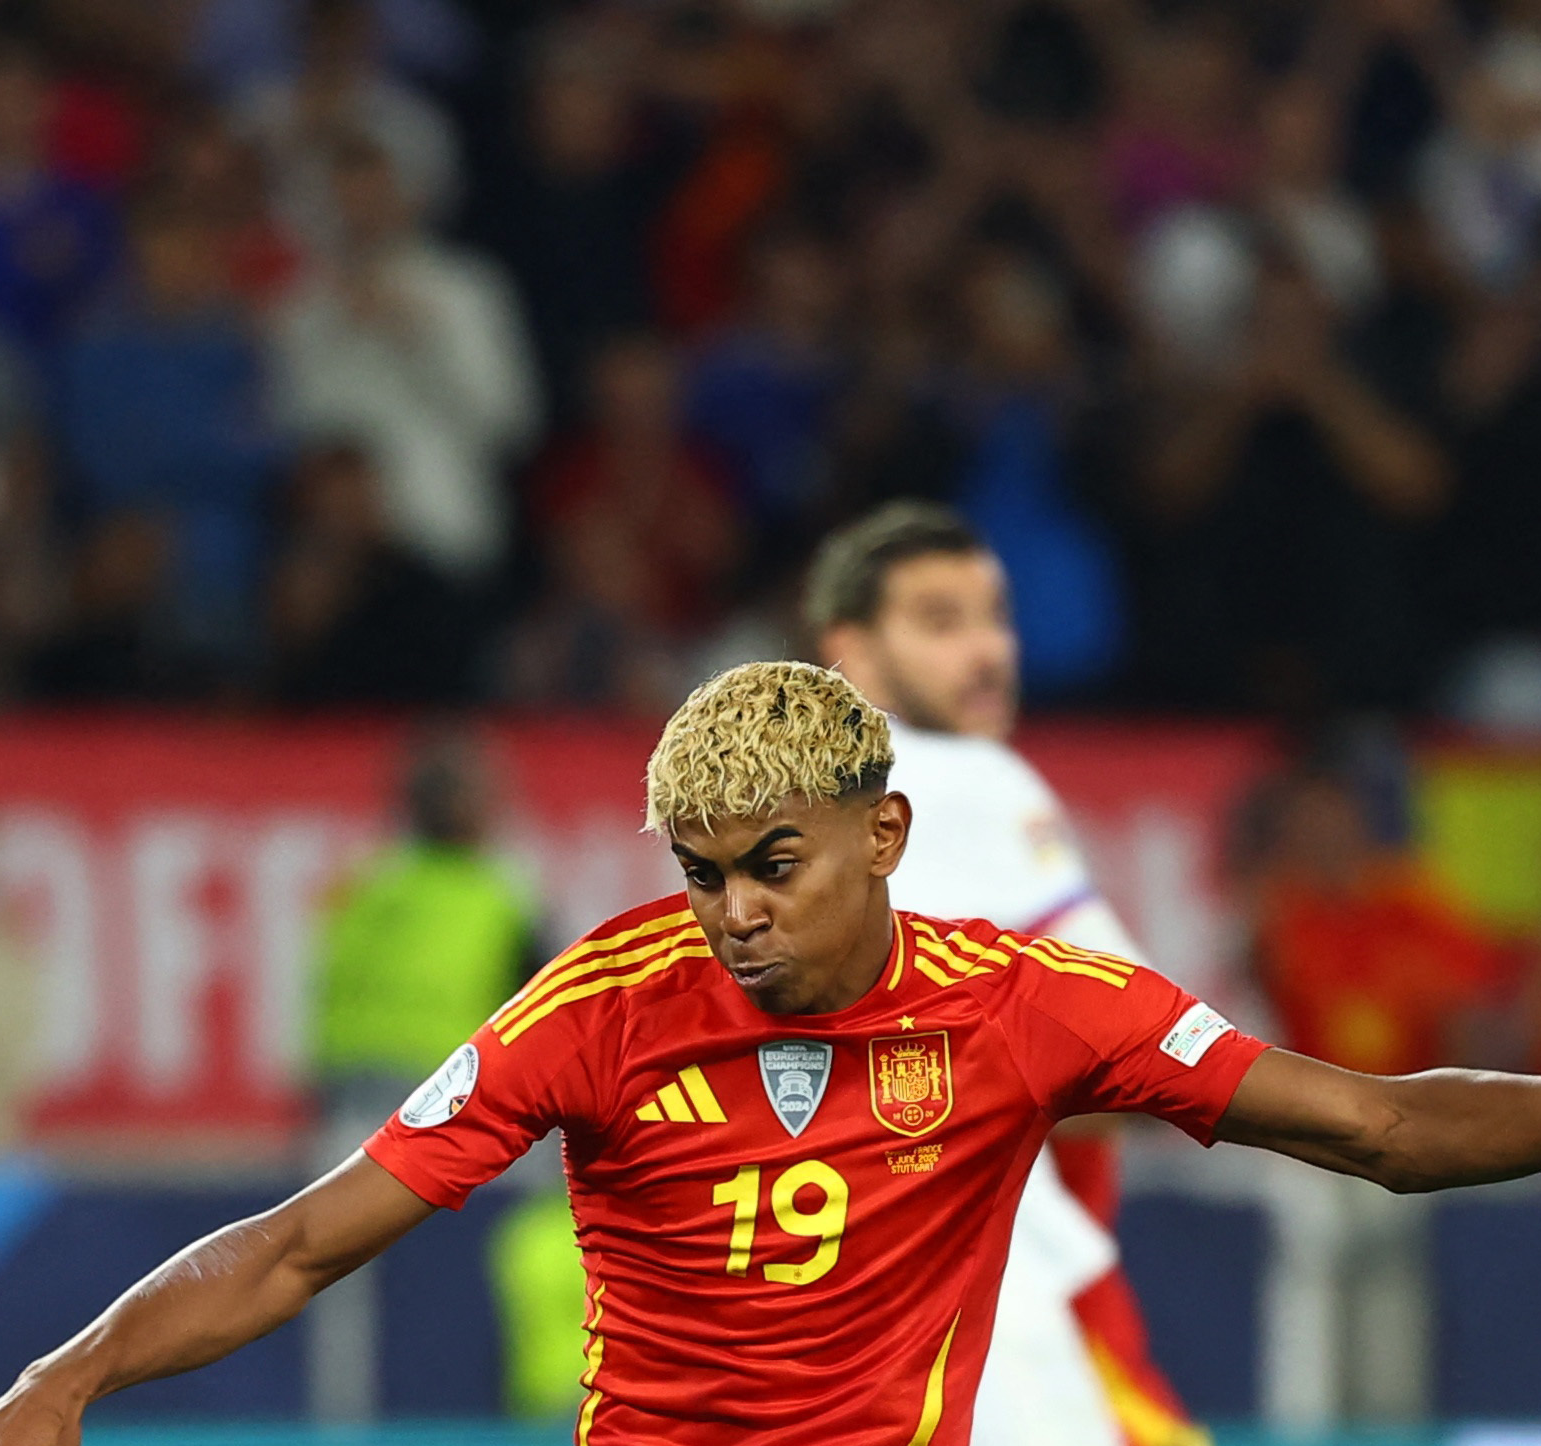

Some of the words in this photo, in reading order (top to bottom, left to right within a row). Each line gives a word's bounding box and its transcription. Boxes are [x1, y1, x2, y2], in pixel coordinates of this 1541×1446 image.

[764, 1051, 825, 1061] EUROPEAN
[765, 1061, 825, 1071] CHAMPIONS
[780, 1100, 811, 1113] 2024
[891, 1162, 935, 1175] STUTTGART
[712, 1159, 850, 1286] 19
